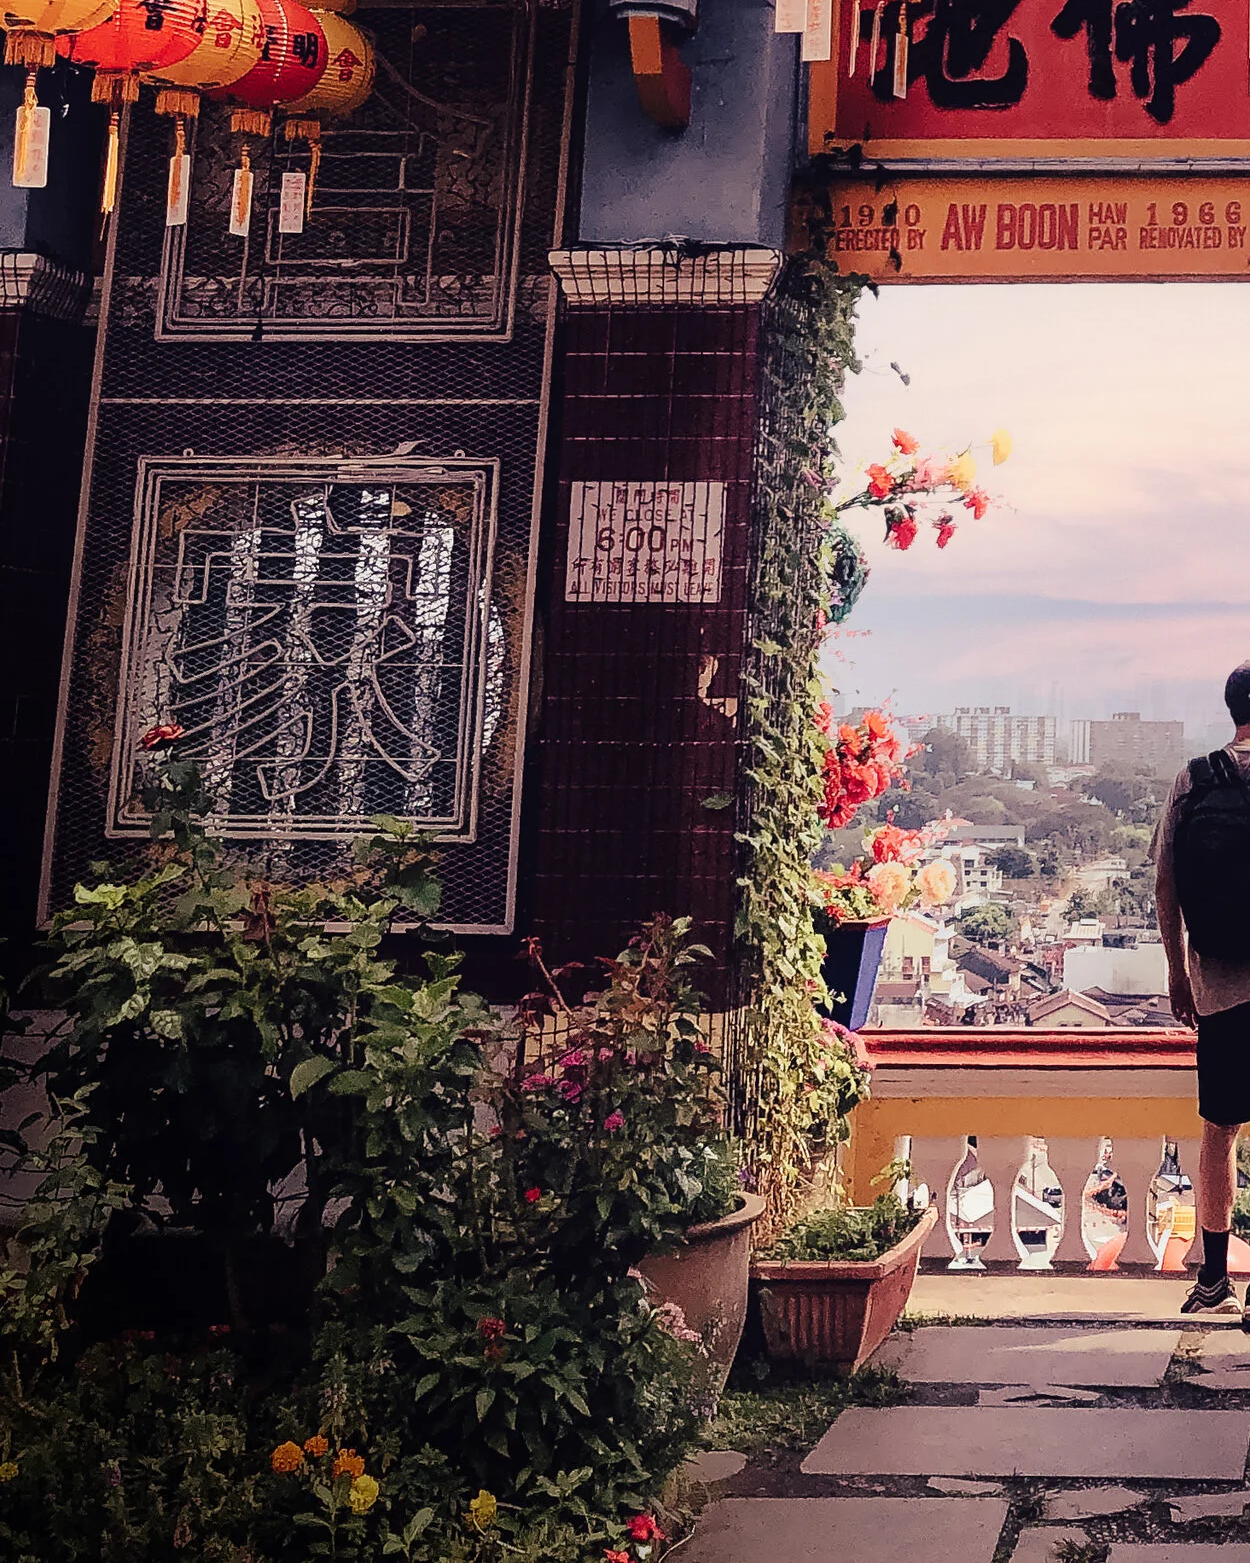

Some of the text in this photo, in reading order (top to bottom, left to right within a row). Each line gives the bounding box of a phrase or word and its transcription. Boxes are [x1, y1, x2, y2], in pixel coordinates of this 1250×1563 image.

[840, 203, 921, 228] 190
[1088, 202, 1128, 225] HAW
[1146, 201, 1242, 226] 1966
[906, 228, 927, 250] BY
[940, 202, 1080, 252] AW BOON
[1087, 226, 1128, 251] PAR
[1139, 226, 1248, 250] RENOVATED BY
[626, 508, 673, 522] CLOSE
[597, 525, 693, 552] 6:00 PM
